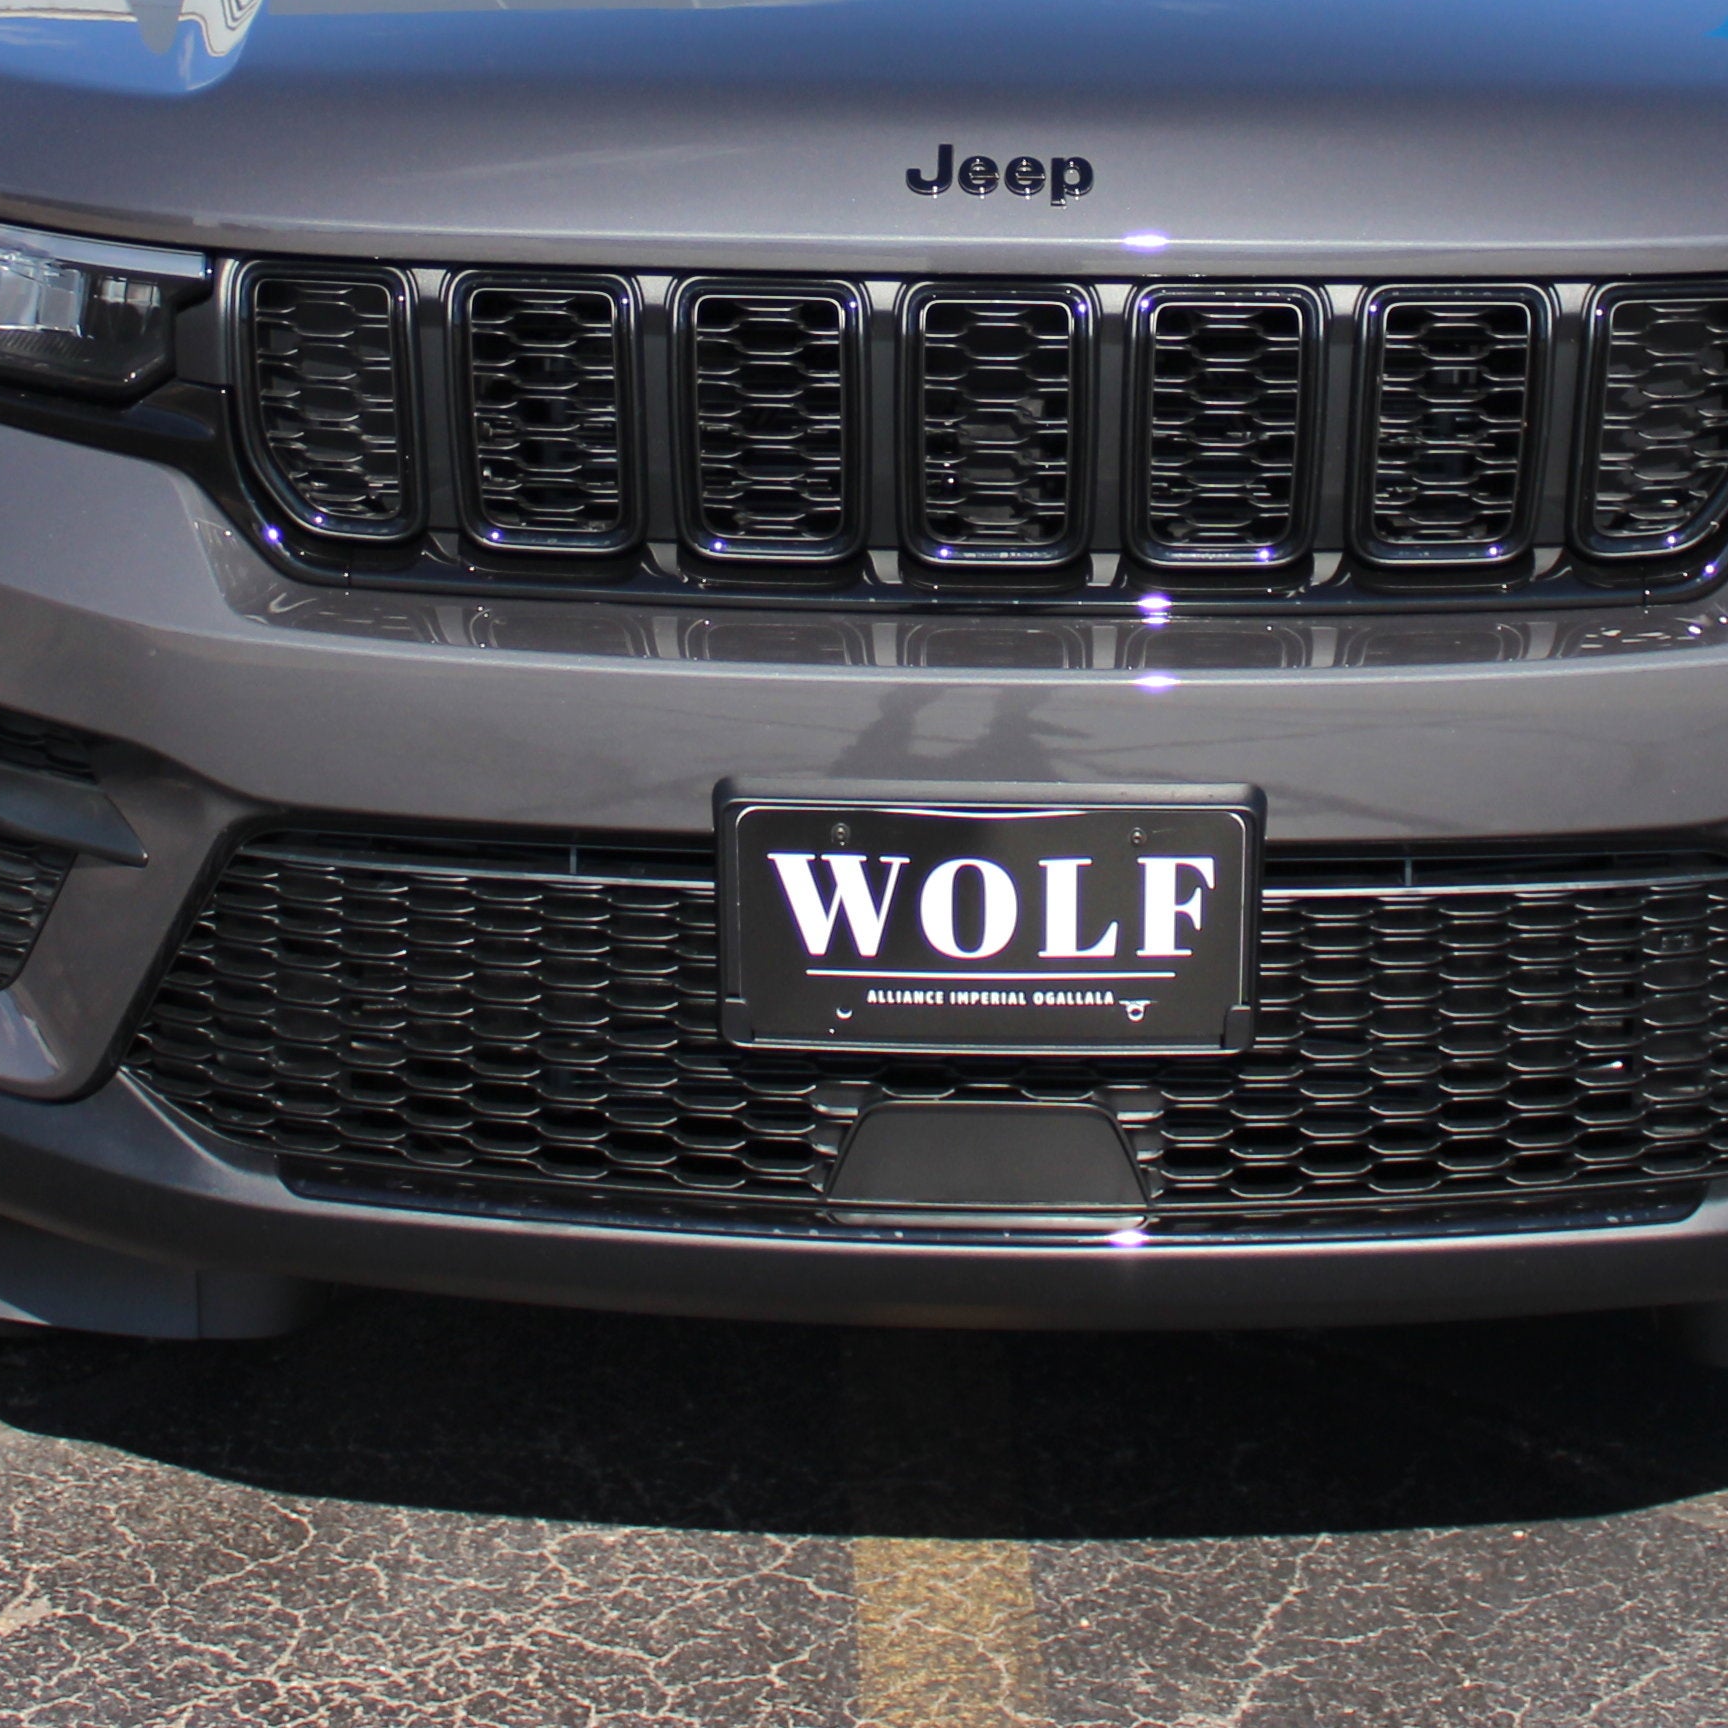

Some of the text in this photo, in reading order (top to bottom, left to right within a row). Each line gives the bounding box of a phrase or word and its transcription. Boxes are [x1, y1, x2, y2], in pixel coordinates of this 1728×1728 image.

[905, 143, 1095, 208] Jeep
[766, 852, 1216, 960] WOLF
[866, 989, 1116, 1007] ALLIANCE IMPERIAL OGALLALA
